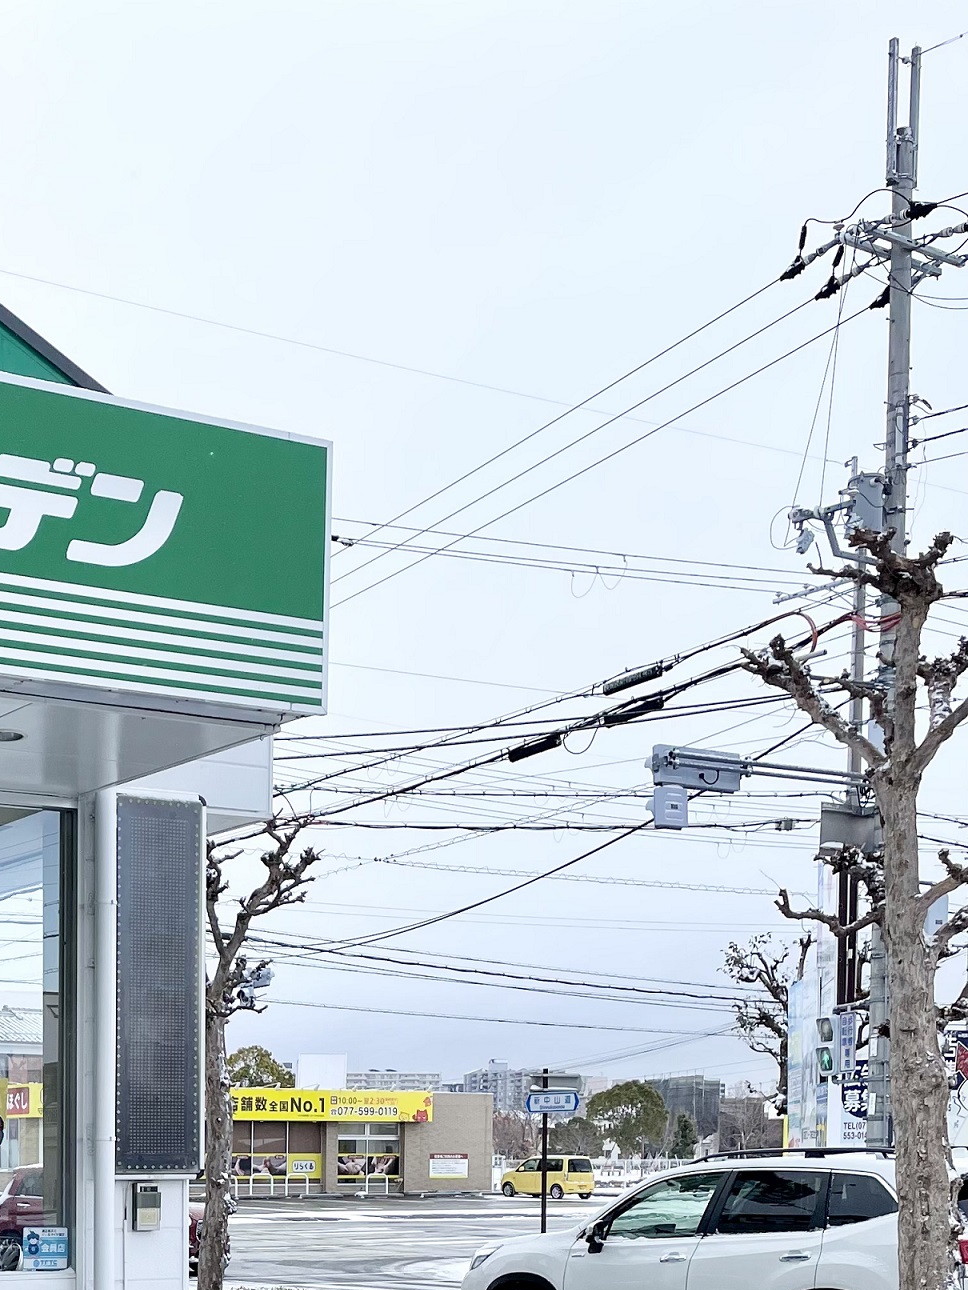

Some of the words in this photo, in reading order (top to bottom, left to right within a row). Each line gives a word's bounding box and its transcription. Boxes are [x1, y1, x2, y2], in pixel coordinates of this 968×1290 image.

[338, 1107, 398, 1116] 077-599-0119
[41, 1243, 65, 1253] 会員店
